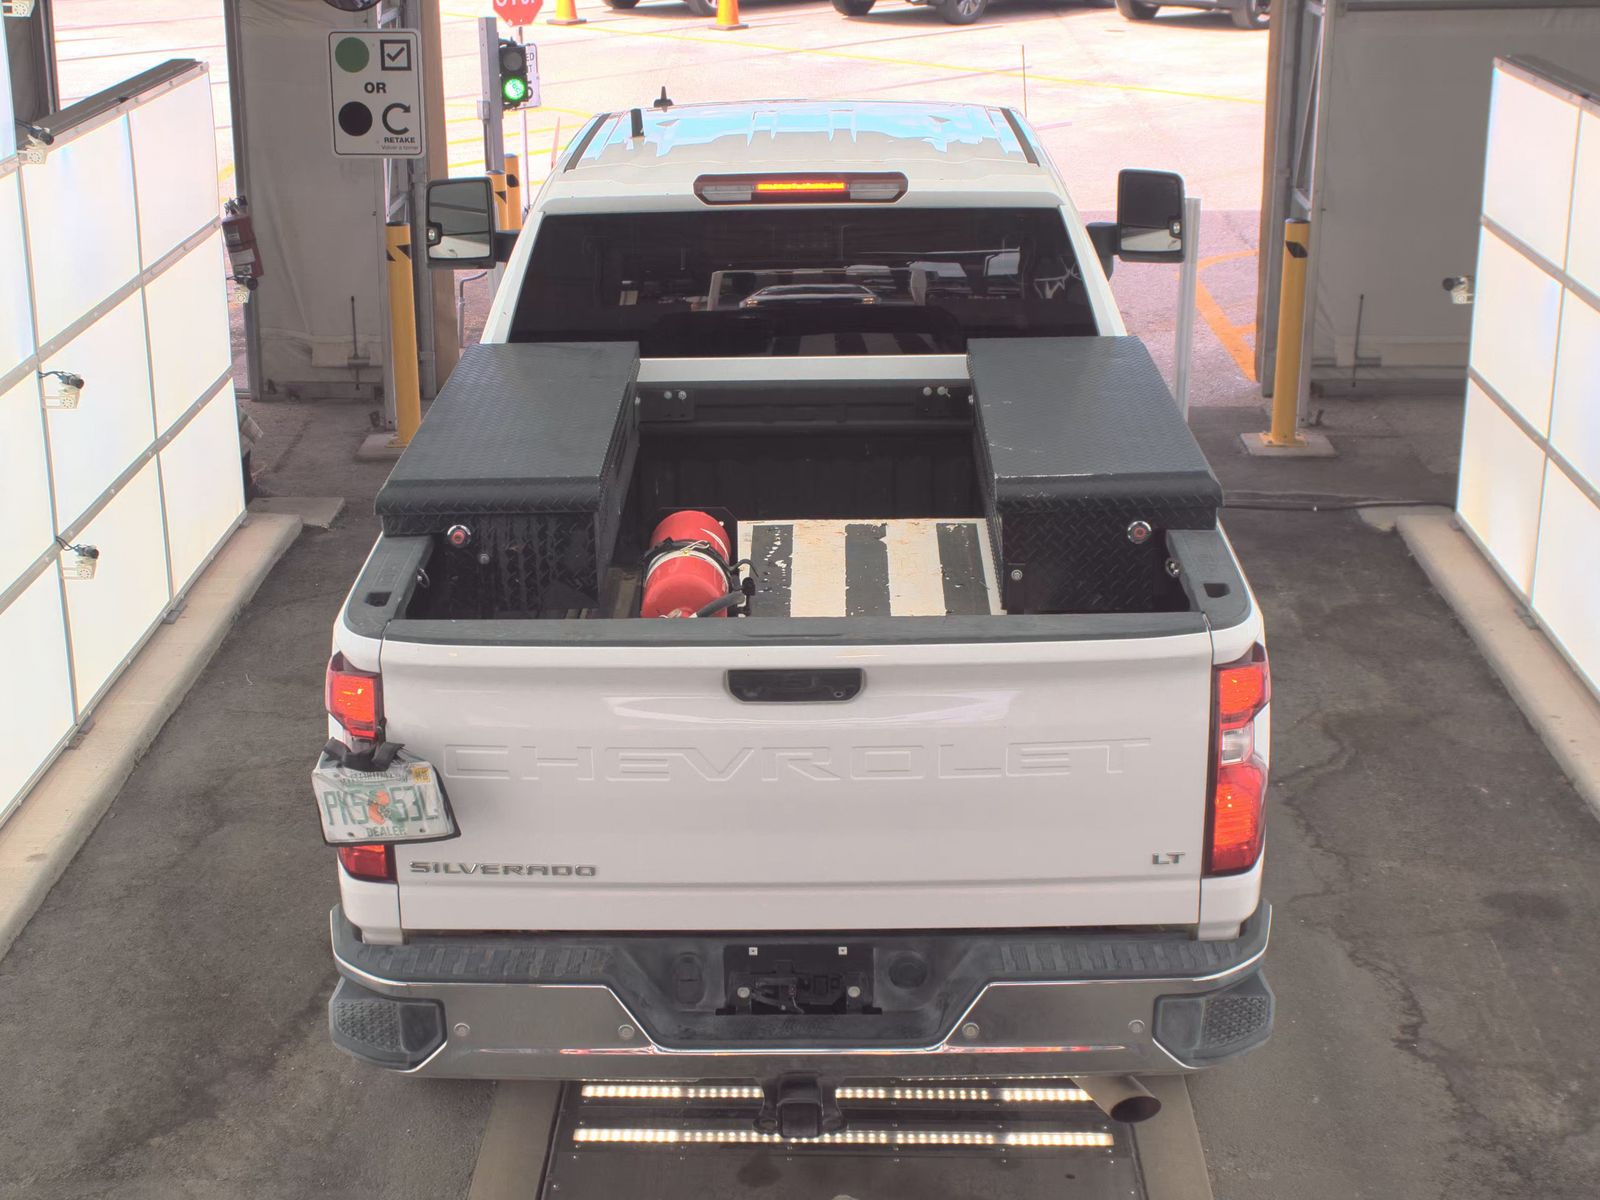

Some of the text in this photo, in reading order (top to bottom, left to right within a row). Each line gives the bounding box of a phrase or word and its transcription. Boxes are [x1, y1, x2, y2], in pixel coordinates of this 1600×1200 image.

[364, 81, 387, 94] OR
[384, 136, 416, 144] RETAKE
[444, 738, 1152, 783] CHEVROLET
[1151, 851, 1186, 865] LT
[409, 861, 597, 877] SILVERADO
